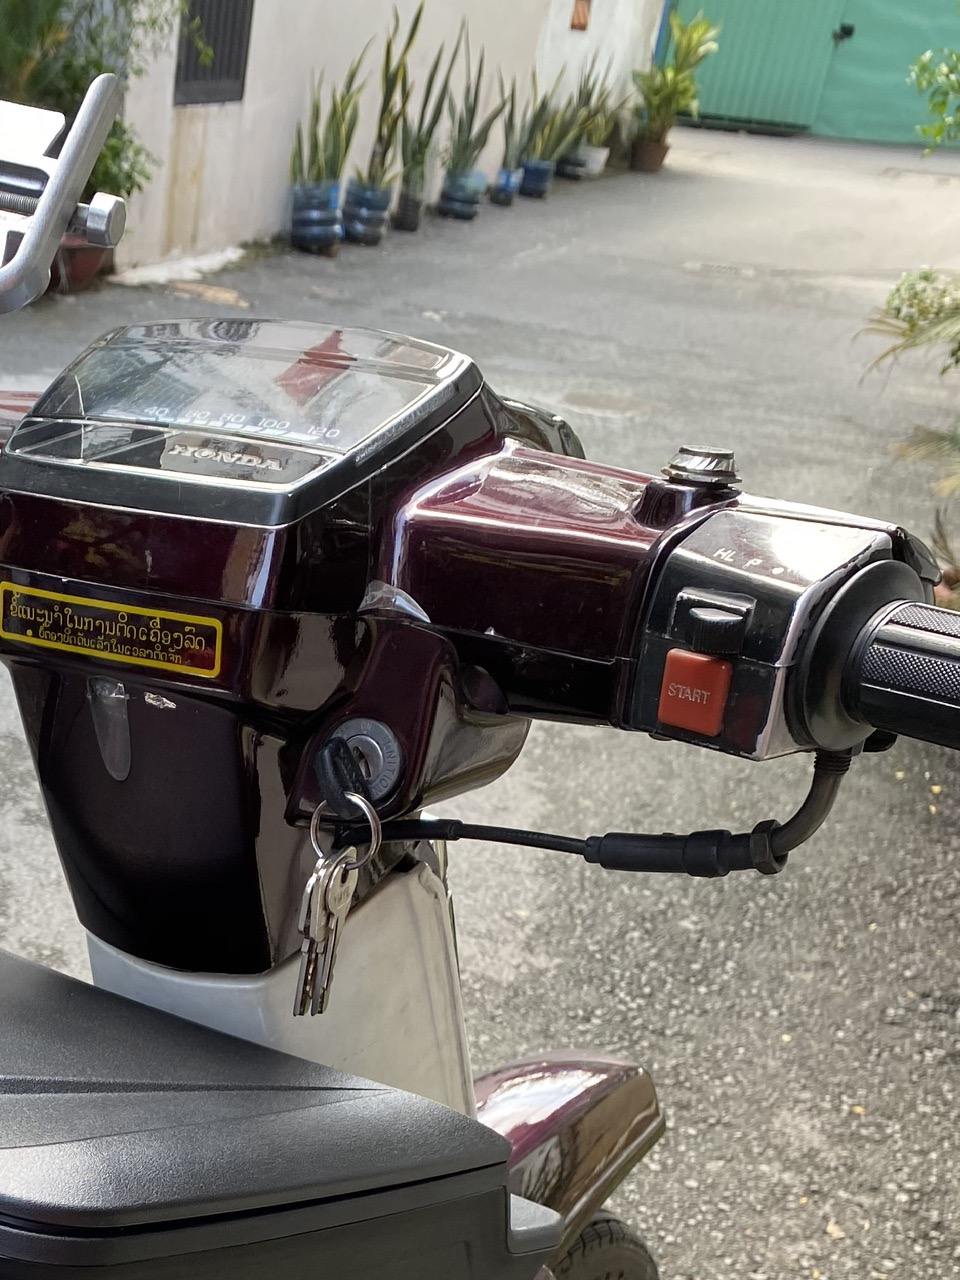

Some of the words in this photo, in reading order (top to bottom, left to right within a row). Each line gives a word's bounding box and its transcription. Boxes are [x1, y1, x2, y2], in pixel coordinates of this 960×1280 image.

[144, 406, 170, 417] 40
[218, 413, 247, 423] 80
[258, 418, 291, 430] 100
[307, 425, 340, 438] 120
[168, 444, 284, 471] HONDA
[712, 547, 737, 562] HL
[668, 682, 711, 705] START
[360, 721, 372, 731] ON
[371, 737, 397, 796] IGNITION
